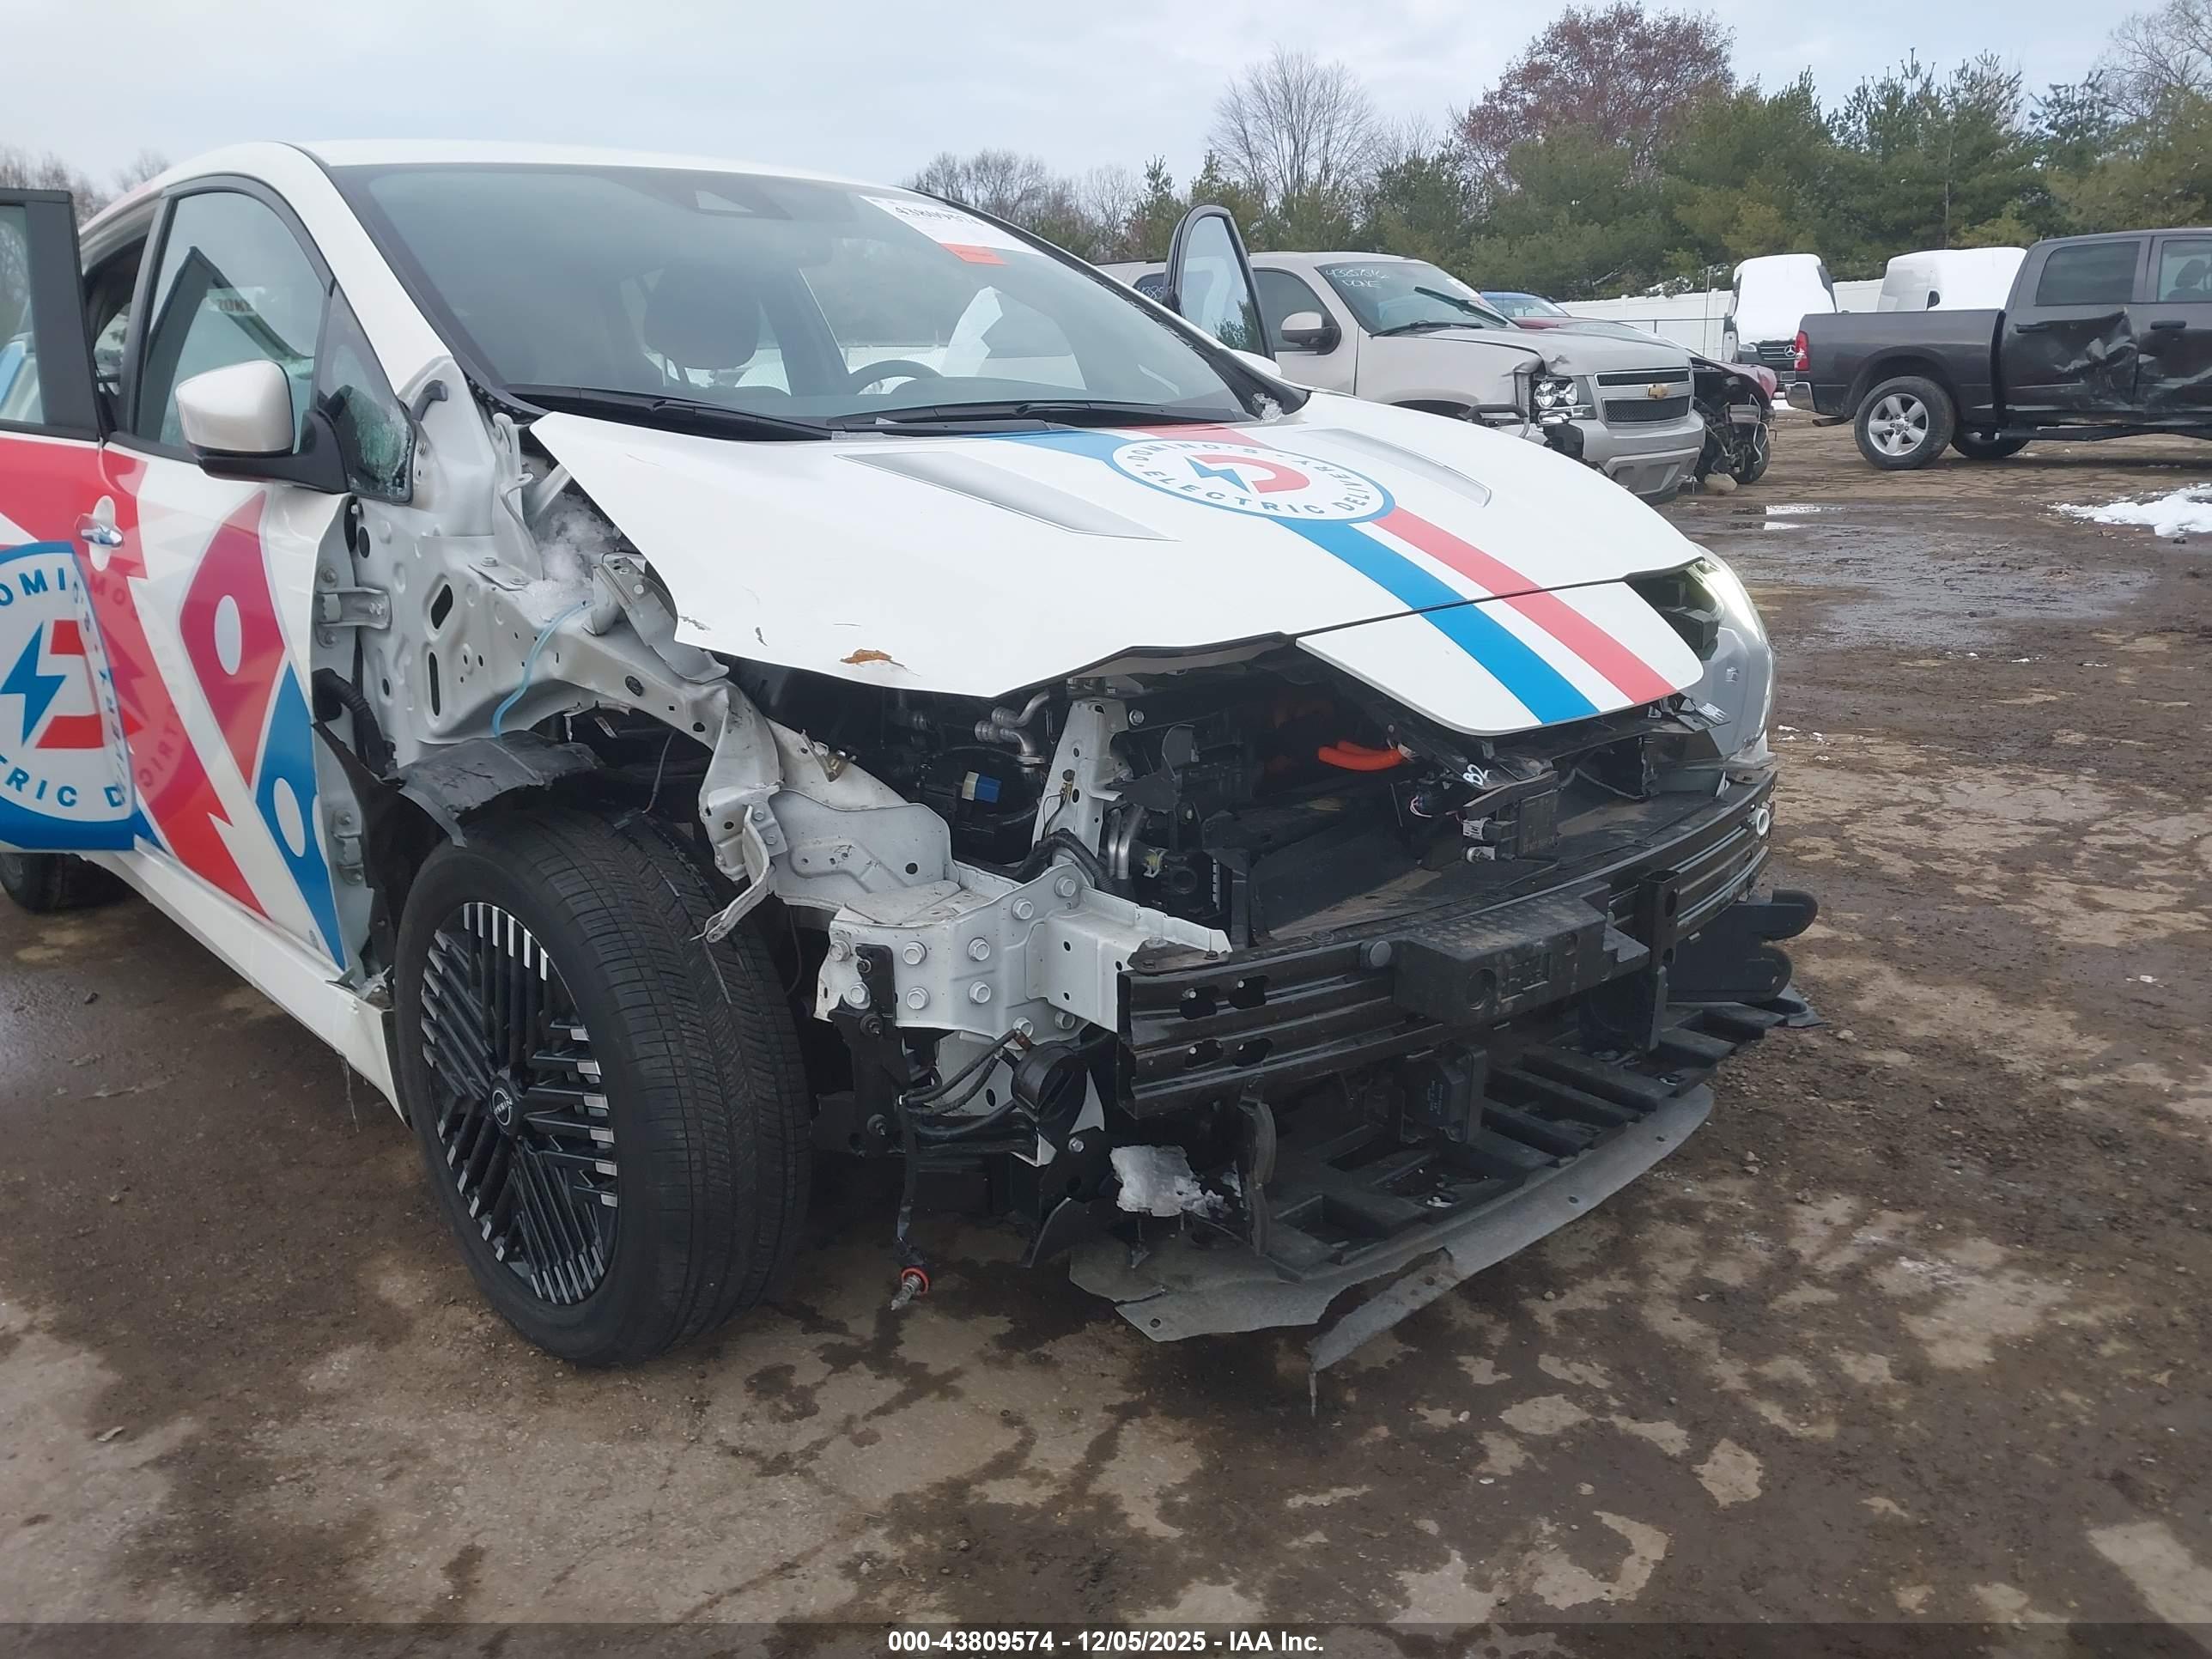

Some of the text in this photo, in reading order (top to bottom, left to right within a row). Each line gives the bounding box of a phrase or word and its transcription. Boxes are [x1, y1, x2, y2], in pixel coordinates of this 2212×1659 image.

[1142, 471, 1325, 514] ELECTRIC
[1291, 460, 1371, 512] DELIVERY
[1462, 763, 1492, 787] B2
